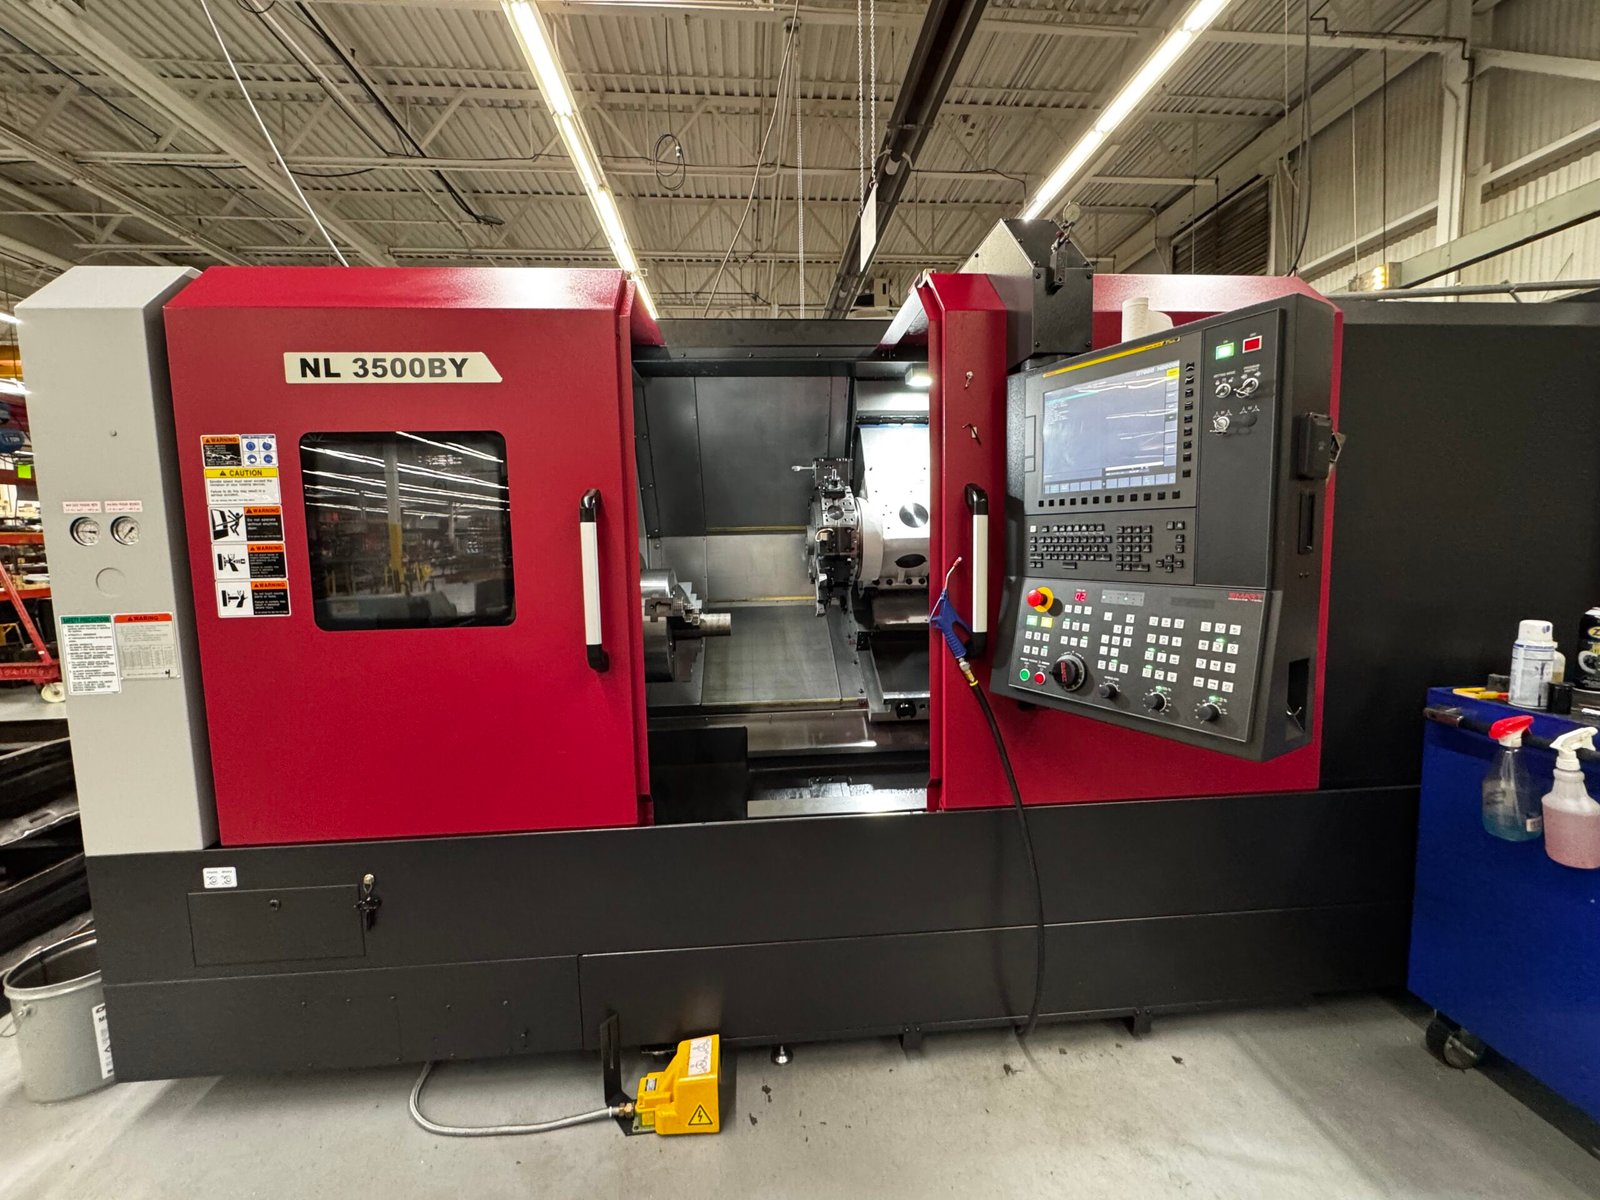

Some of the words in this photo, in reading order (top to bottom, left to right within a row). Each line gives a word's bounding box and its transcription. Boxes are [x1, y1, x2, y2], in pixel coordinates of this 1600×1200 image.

[299, 357, 341, 379] NL
[352, 357, 469, 379] 3500BY
[229, 469, 263, 477] CAUTION
[1074, 592, 1087, 602] 02
